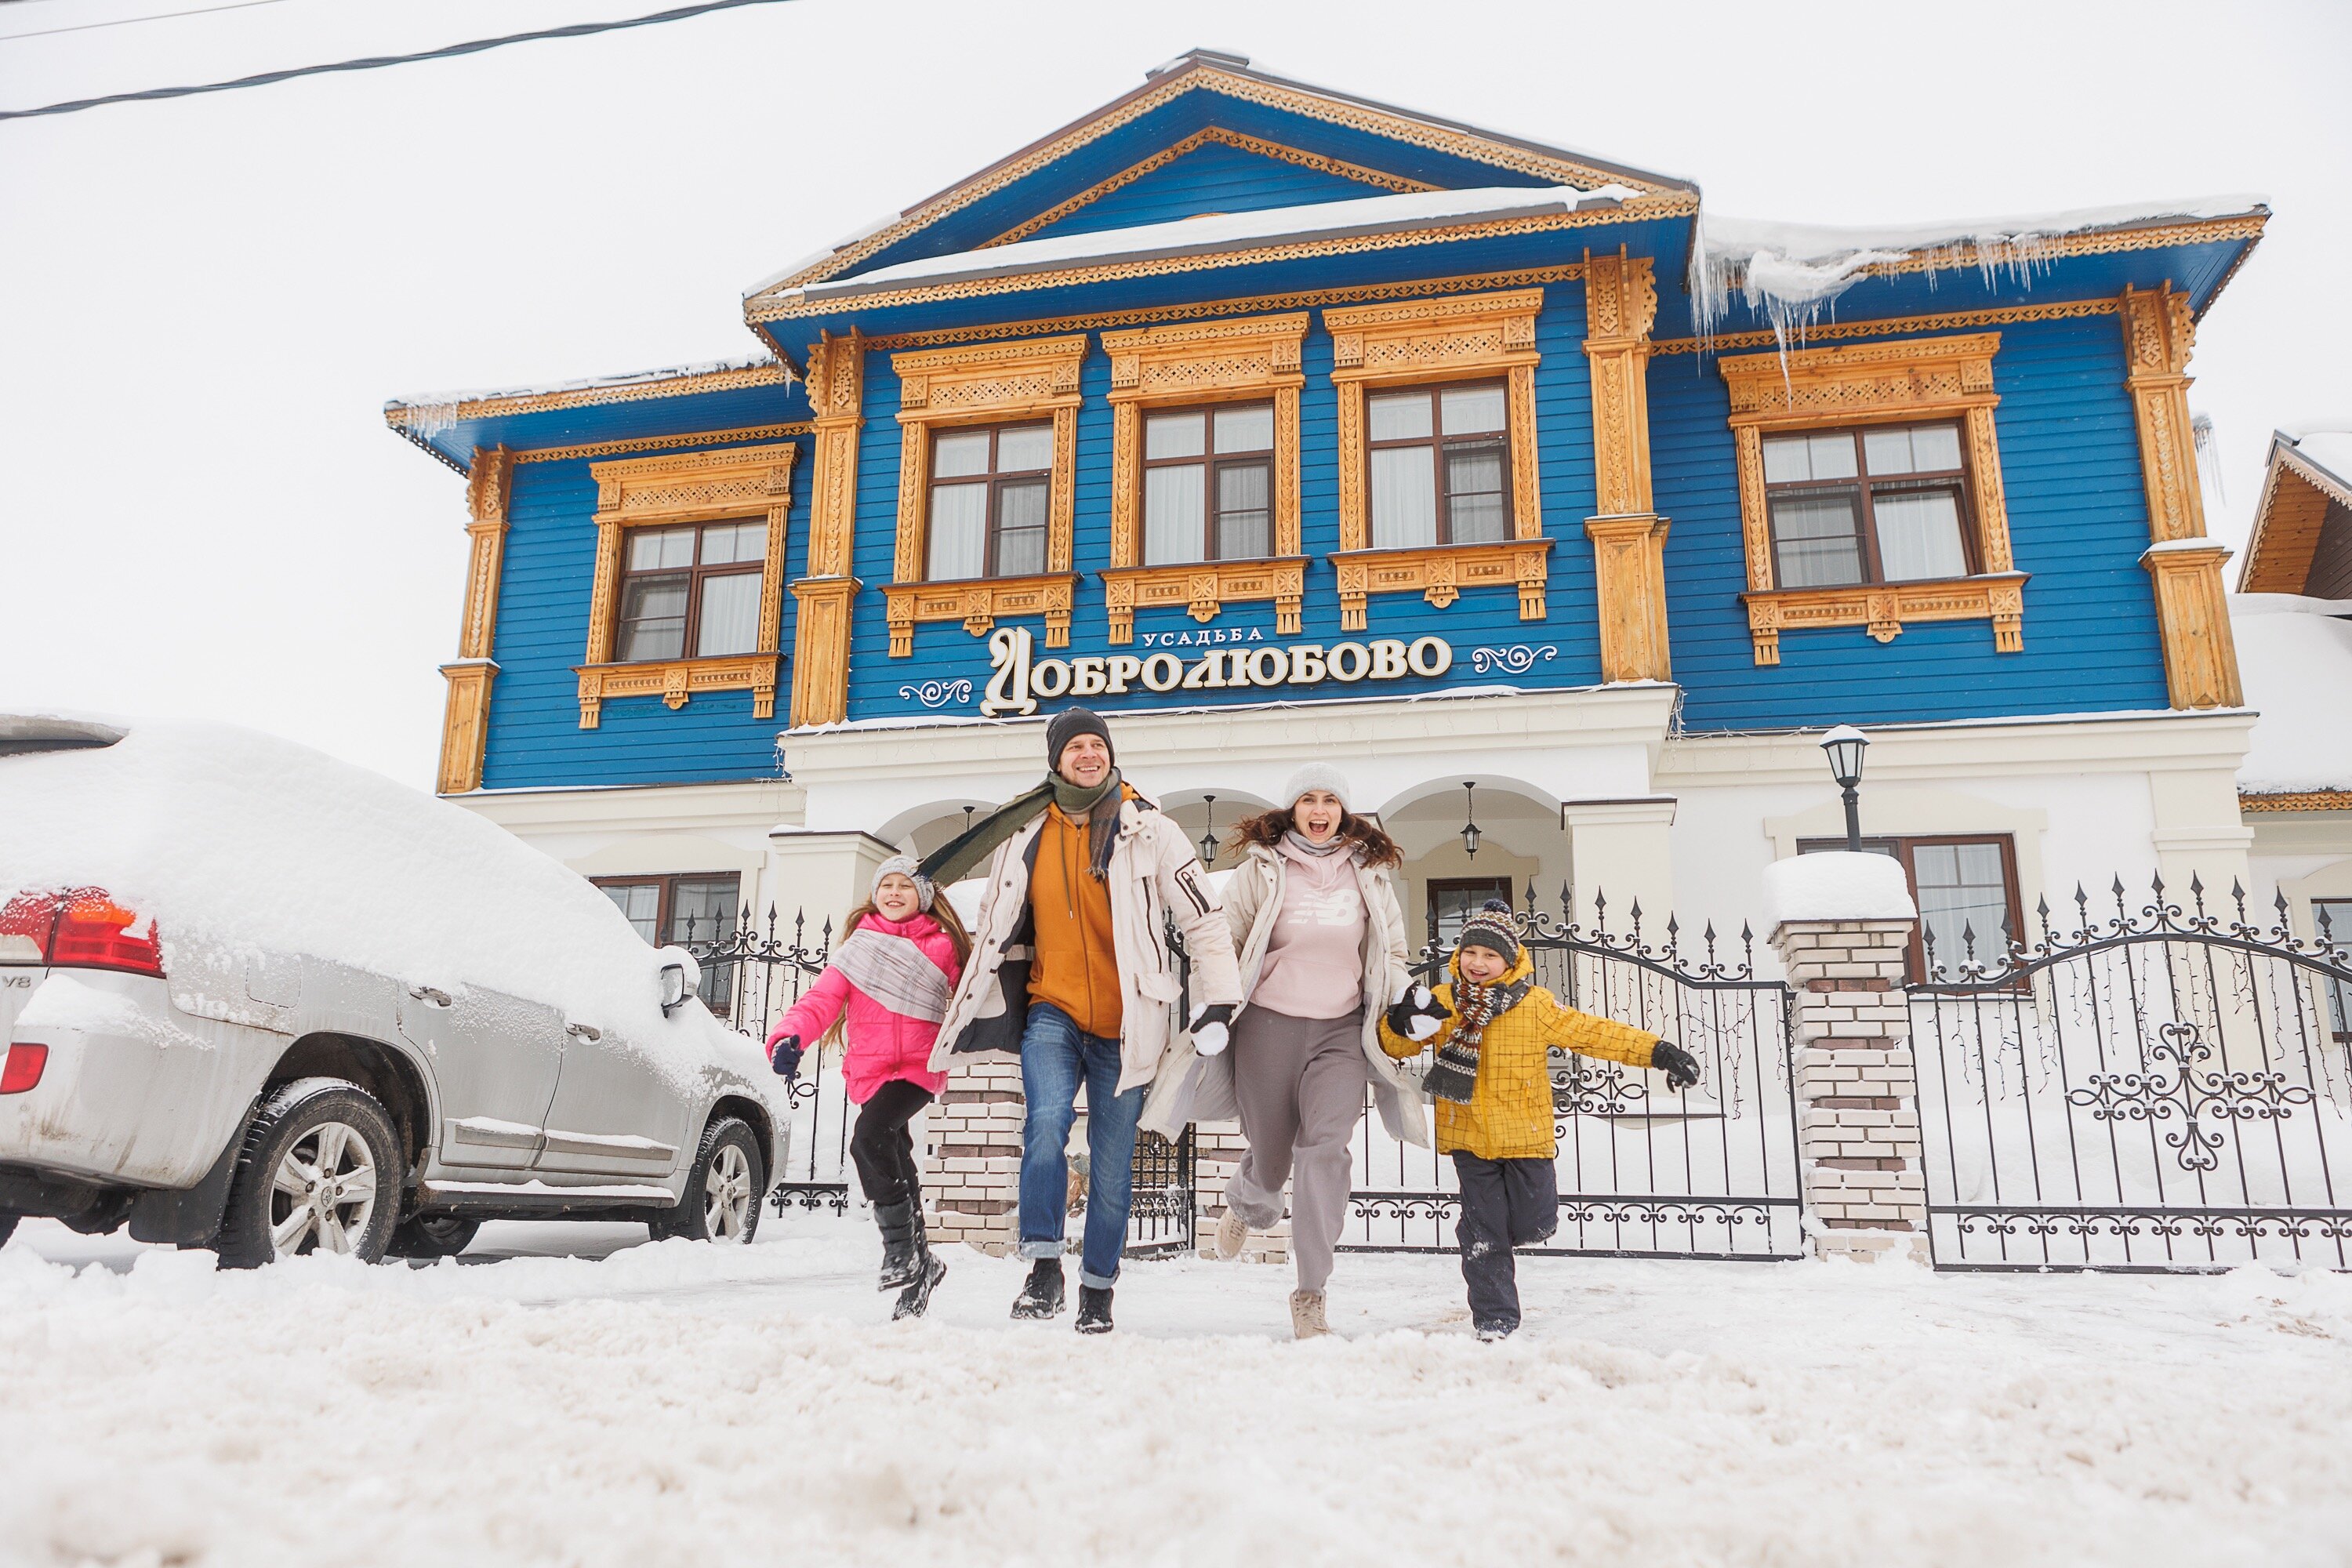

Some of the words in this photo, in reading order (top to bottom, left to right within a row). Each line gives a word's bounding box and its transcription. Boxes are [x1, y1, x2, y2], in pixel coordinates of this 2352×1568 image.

[1142, 627, 1264, 647] УСАДЬБА
[979, 626, 1453, 717] ДОБРОЛЮБОВО
[2, 975, 31, 989] V8
